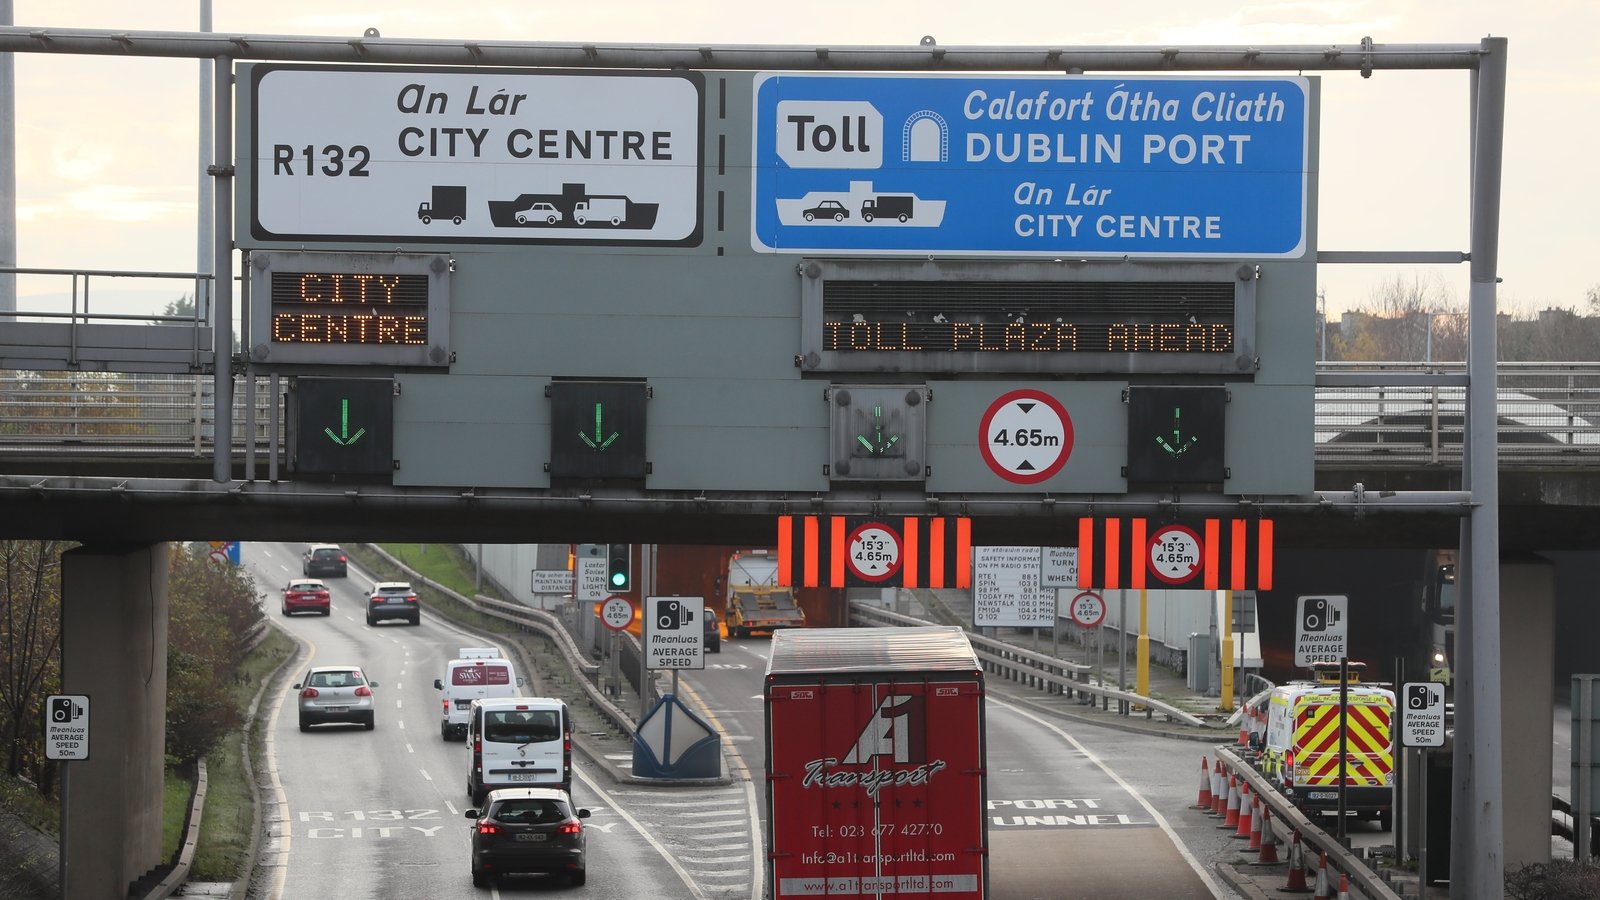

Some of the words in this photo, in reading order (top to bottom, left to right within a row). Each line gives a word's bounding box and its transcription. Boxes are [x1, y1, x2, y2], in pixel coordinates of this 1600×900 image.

[397, 83, 448, 114] An
[466, 86, 527, 115] Lár
[963, 89, 1093, 122] Calafort
[1105, 83, 1180, 123] Átha
[1190, 91, 1286, 123] Cliath
[787, 115, 871, 153] Toll
[398, 127, 489, 157] CITY
[507, 129, 673, 161] CENTRE
[966, 132, 1121, 164] DUBLIN
[1144, 134, 1251, 165] PORT
[273, 144, 371, 178] R132
[1014, 182, 1051, 205] An
[1065, 183, 1112, 207] Lár
[1014, 216, 1083, 238] CITY
[1096, 216, 1222, 240] CENTRE
[300, 273, 400, 303] CITY
[274, 314, 426, 345] CENTRE
[825, 321, 923, 351] TOLL
[954, 322, 1077, 352] PLAZA
[1108, 323, 1233, 353] AHEAD
[994, 428, 1059, 447] 4.65m
[855, 552, 892, 562] 4.65m
[1156, 553, 1194, 564] 4.65m
[652, 634, 698, 644] Meanluas
[1300, 634, 1343, 642] Meanluas
[652, 648, 698, 656] AVERAGE
[1298, 645, 1344, 653] AVERAGE
[659, 658, 691, 667] SPEED
[1305, 655, 1337, 663] SPEED
[842, 694, 926, 764] A1
[803, 758, 946, 795] Transport
[987, 798, 1102, 810] PORT
[299, 809, 442, 822] R132
[987, 814, 1151, 826] UNNEL
[308, 826, 444, 839] CITY
[812, 826, 834, 838] Tel:
[802, 849, 955, 865] Info@a1tansprtltd.com
